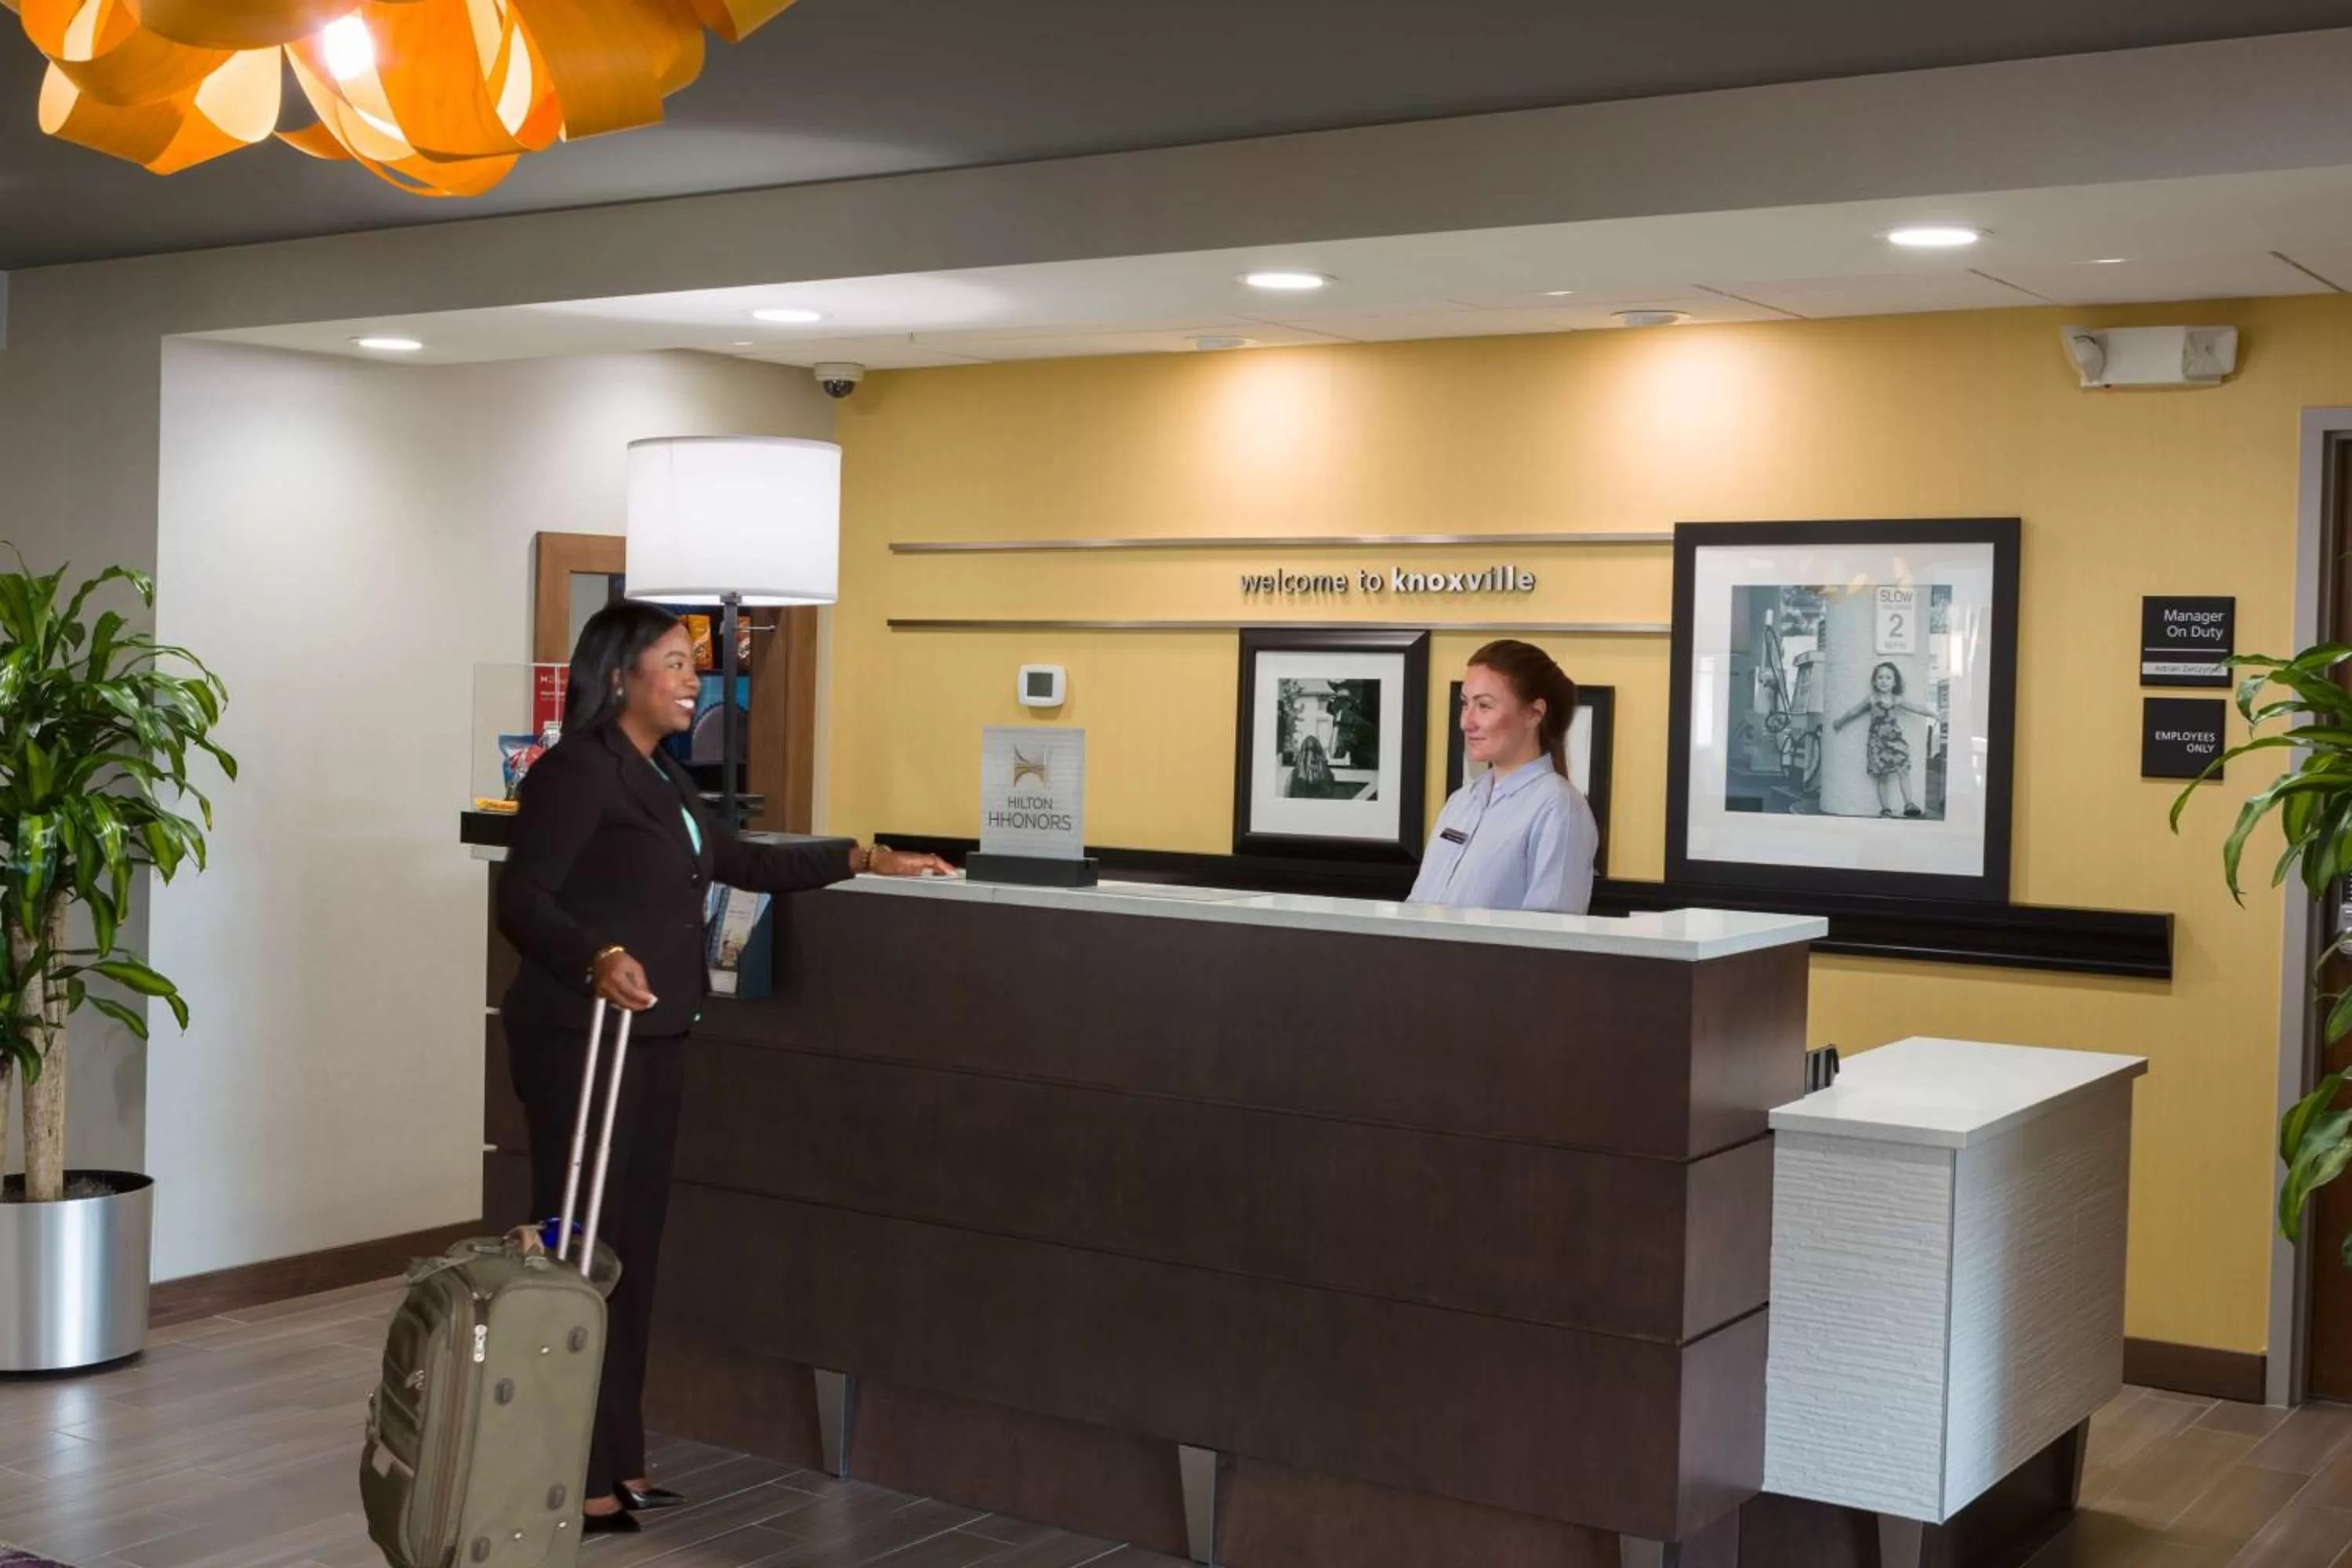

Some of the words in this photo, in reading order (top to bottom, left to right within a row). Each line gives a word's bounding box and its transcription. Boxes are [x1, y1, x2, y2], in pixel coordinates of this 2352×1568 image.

[1241, 568, 1348, 594] welcome
[1358, 569, 1385, 593] to
[1392, 565, 1536, 593] knoxville
[1880, 589, 1913, 603] SLOW
[1889, 613, 1904, 637] 2
[2164, 609, 2225, 625] Manager
[2166, 625, 2187, 637] On
[2191, 626, 2223, 641] Duty
[2154, 731, 2215, 742] EMPLOYEES
[2187, 743, 2215, 753] ONLY
[1007, 796, 1053, 810] HILTON
[988, 811, 1071, 831] HHONORS
